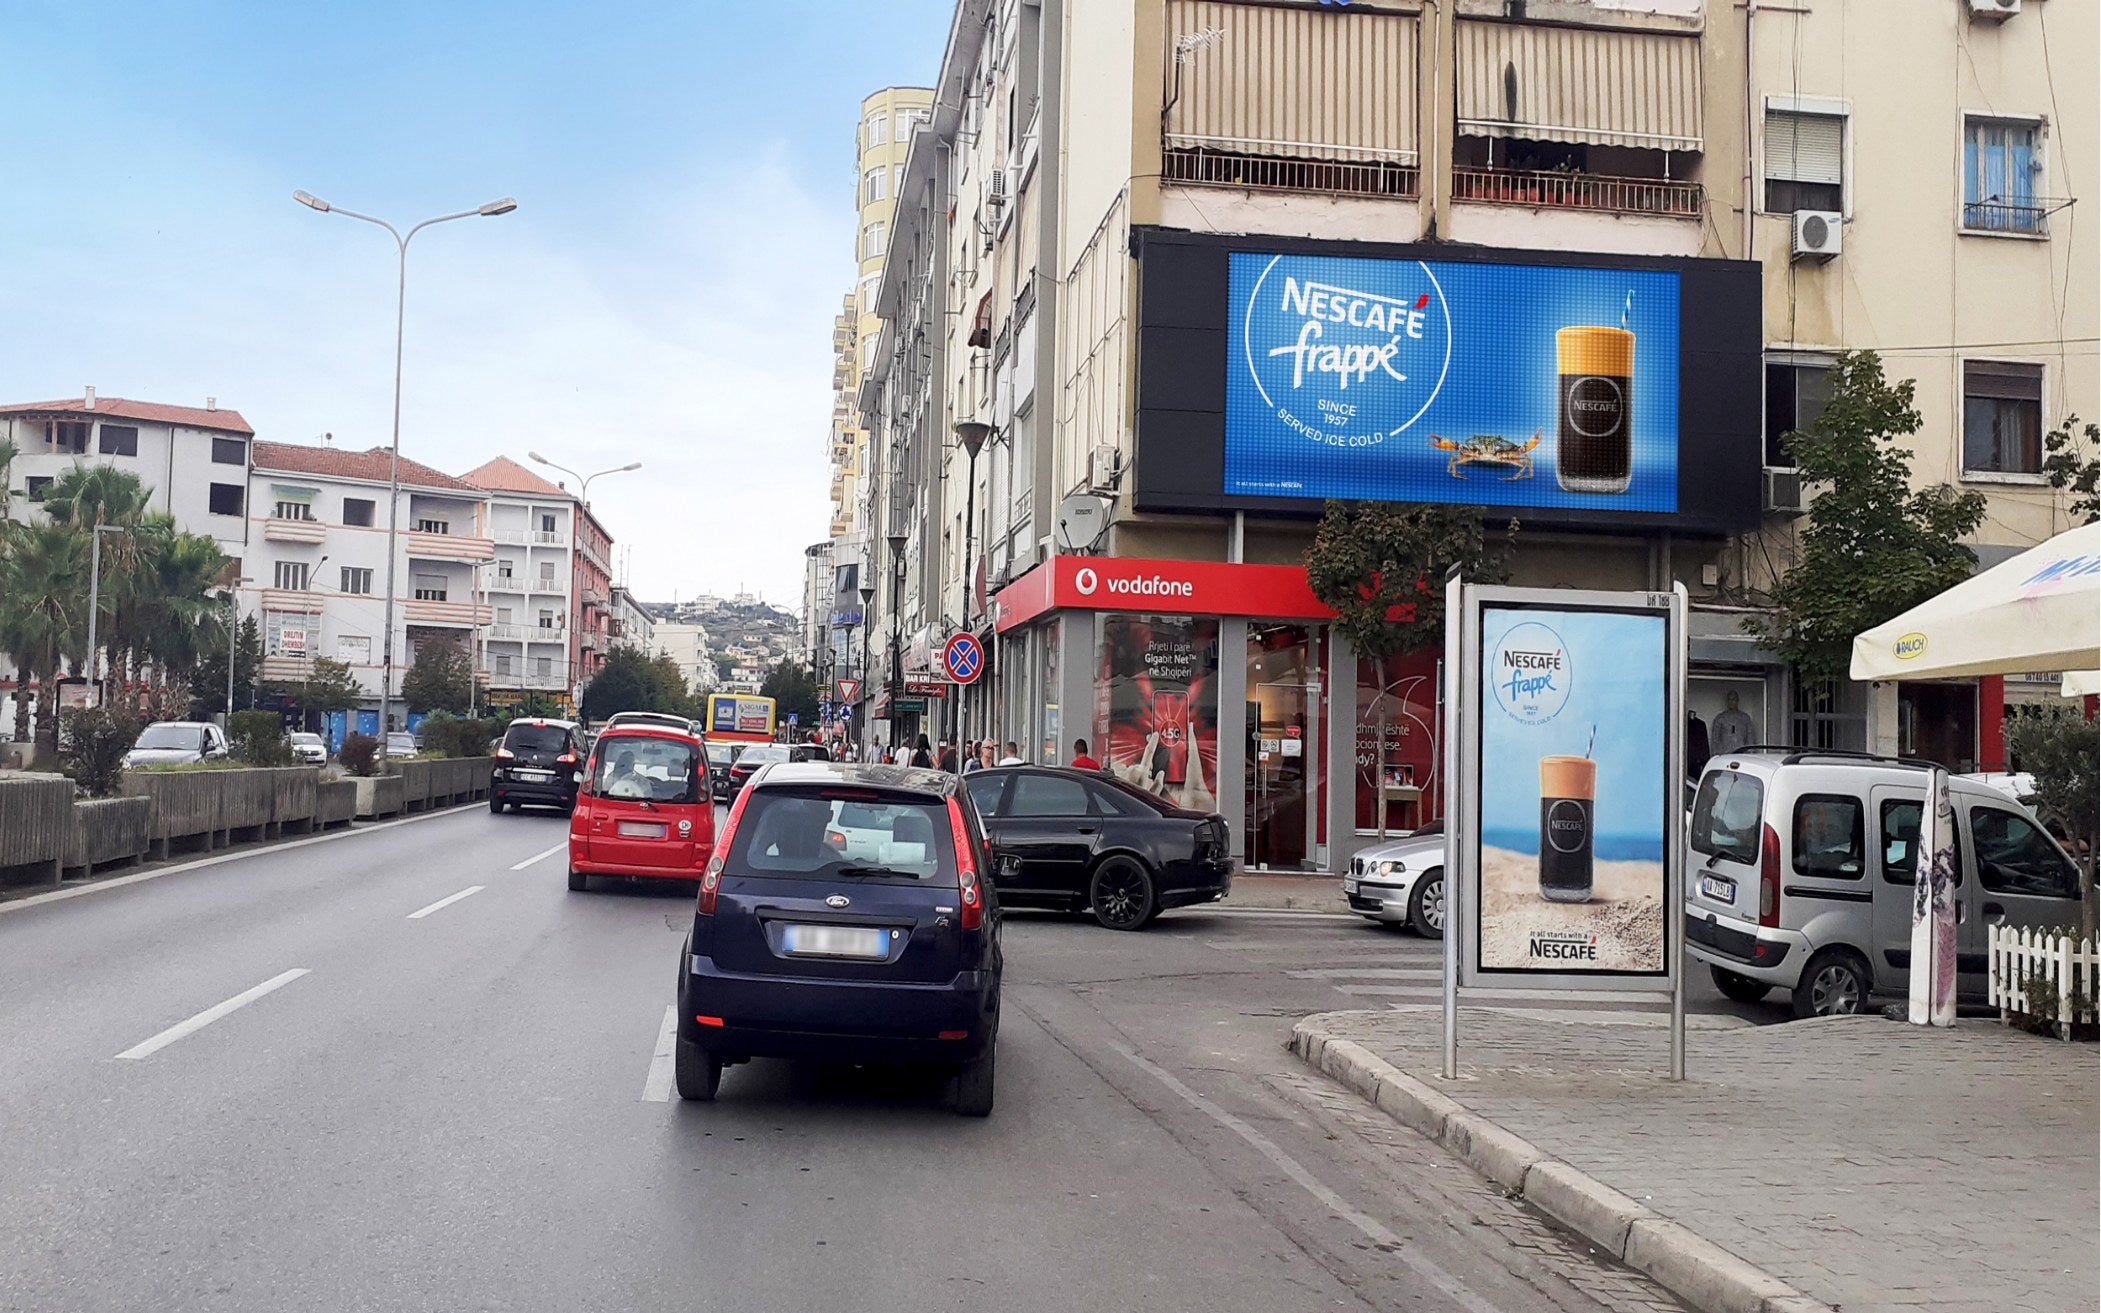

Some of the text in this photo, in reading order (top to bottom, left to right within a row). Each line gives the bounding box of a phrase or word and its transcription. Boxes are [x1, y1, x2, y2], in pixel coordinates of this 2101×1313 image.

[1281, 276, 1429, 339] NESCAFÉ
[1268, 320, 1407, 390] frappé
[1317, 399, 1357, 416] SINCE
[1573, 398, 1618, 412] NESCAFÉ
[1277, 408, 1383, 447] SERVED ICE COLD
[1324, 413, 1348, 426] 1957
[1107, 574, 1193, 596] vodafone
[1901, 638, 1924, 653] RAUCH
[1504, 649, 1561, 670] NESCAFÉ
[1502, 669, 1557, 702] frappé
[1552, 819, 1584, 831] NESCAFÉ
[1529, 935, 1597, 961] NESCAFÉ
